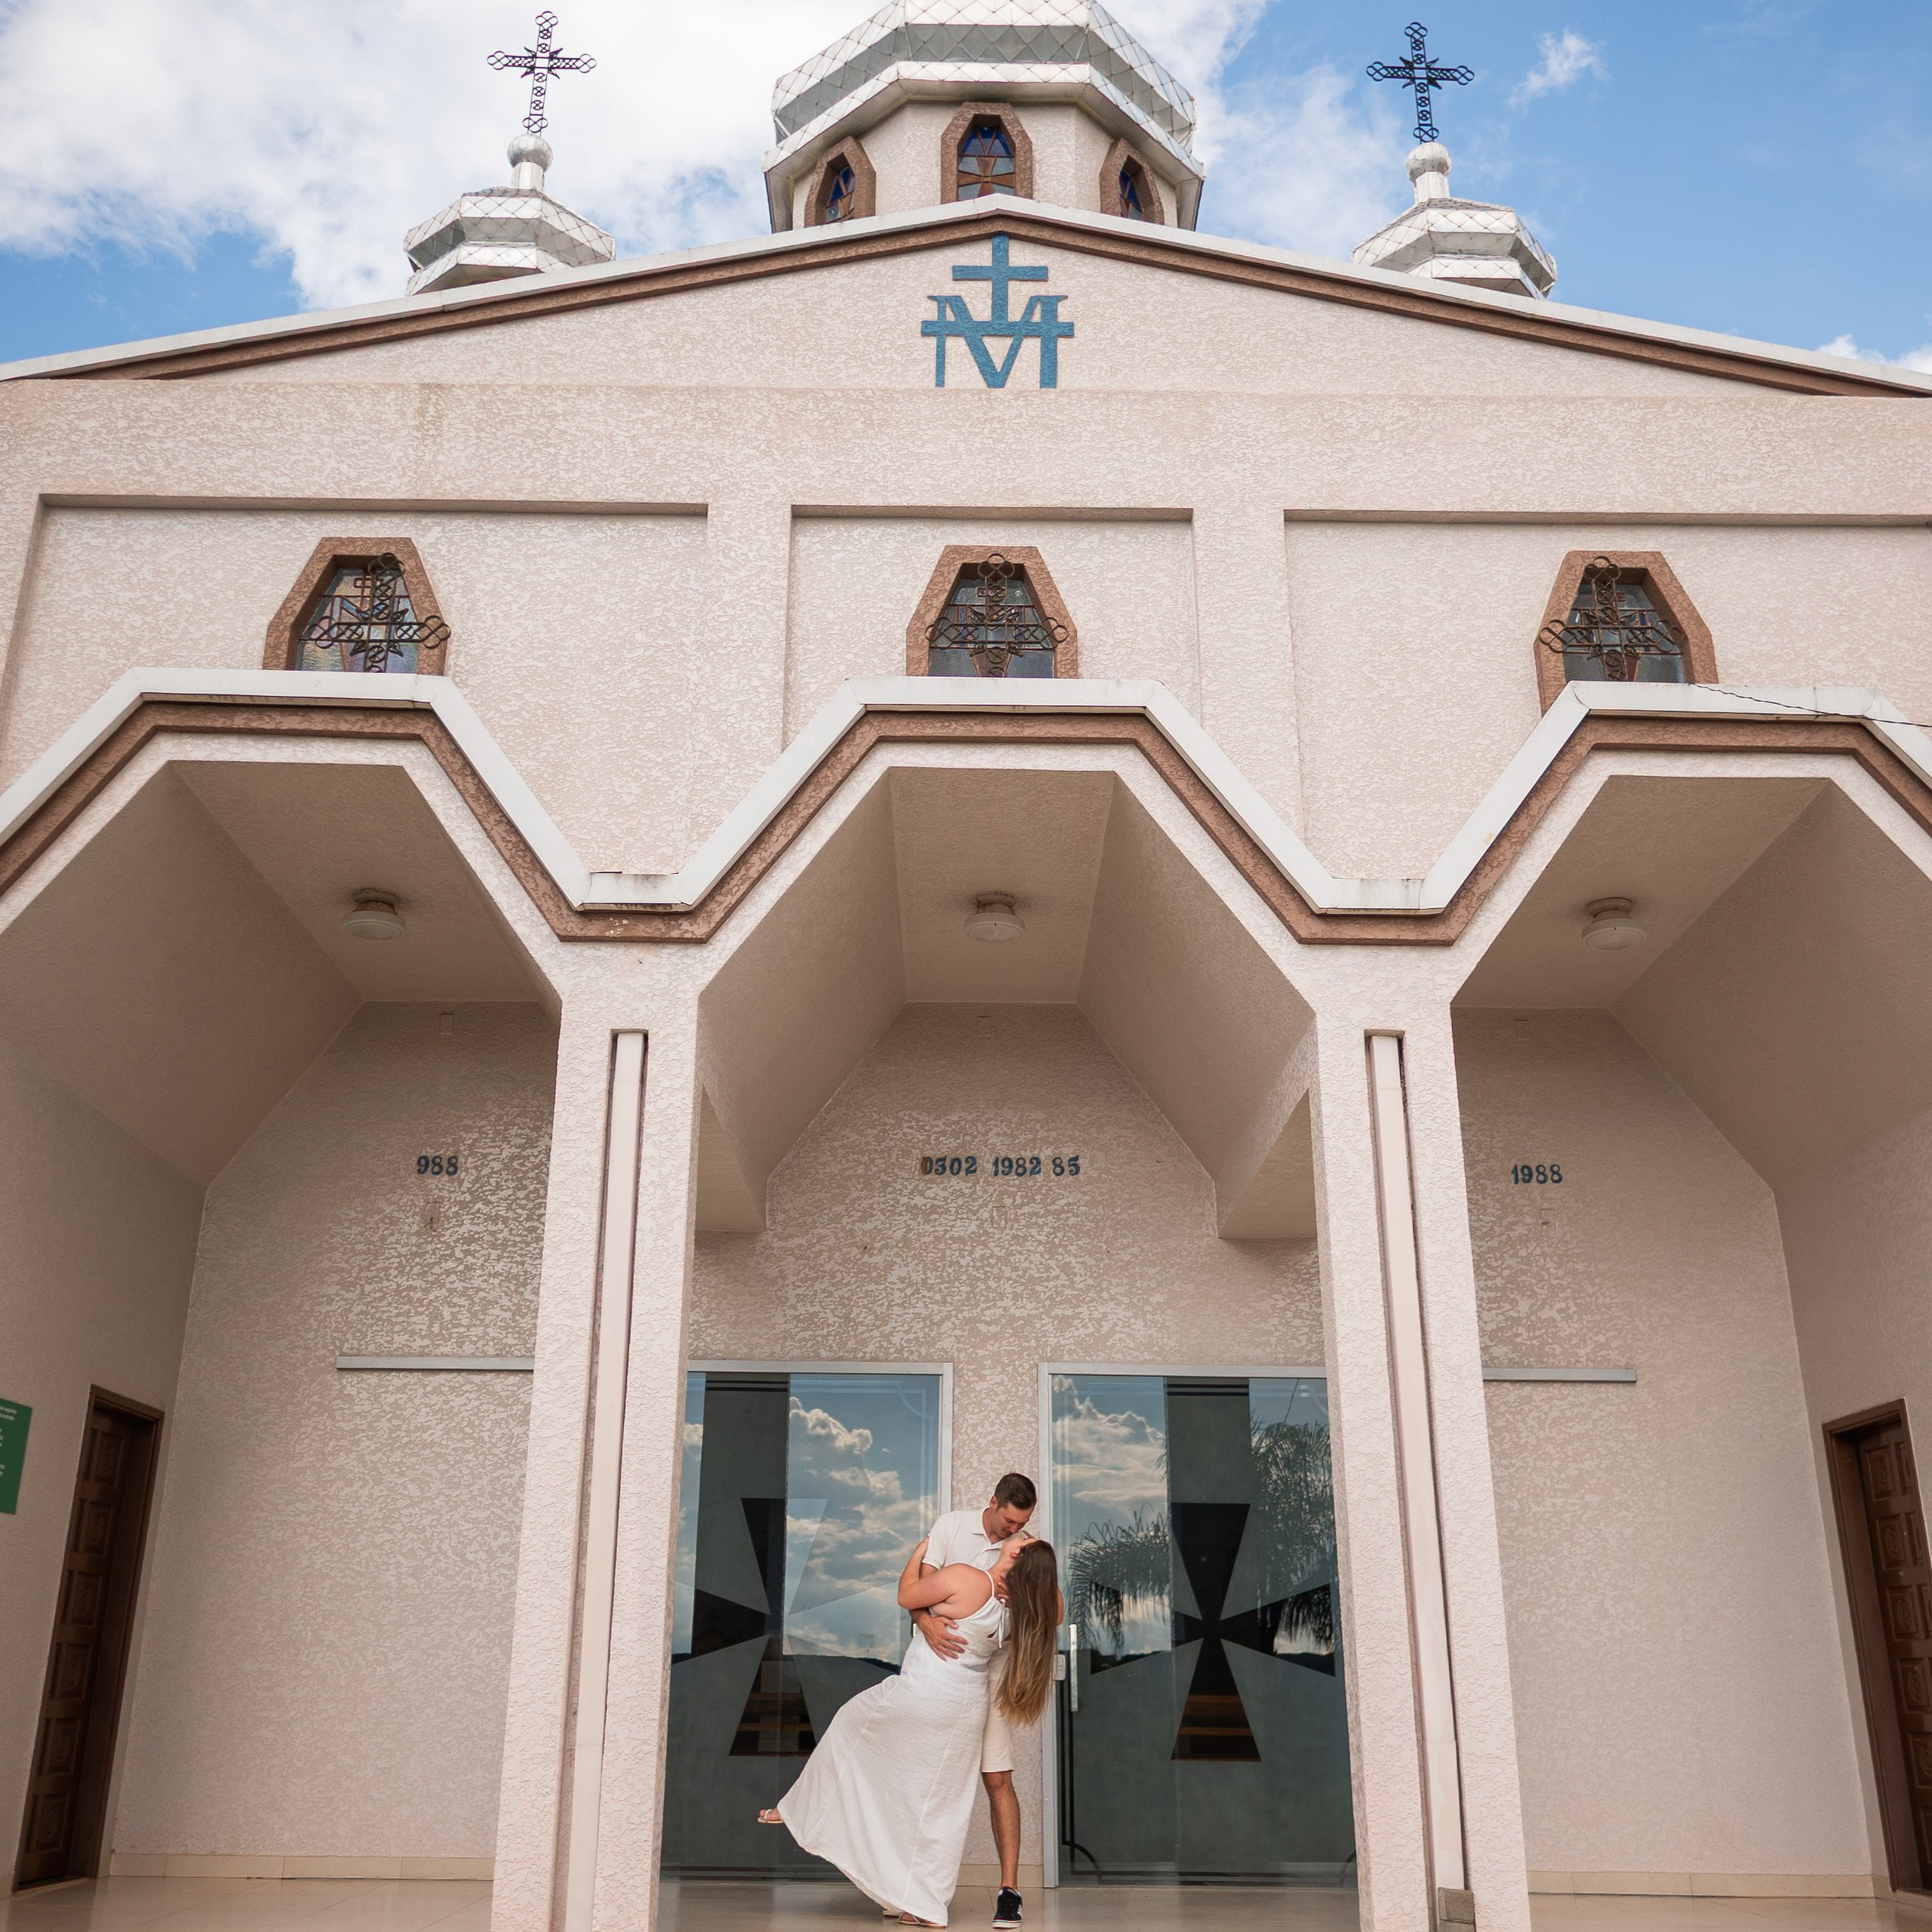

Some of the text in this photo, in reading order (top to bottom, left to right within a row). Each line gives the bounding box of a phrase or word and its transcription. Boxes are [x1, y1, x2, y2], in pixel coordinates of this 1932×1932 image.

[417, 1155, 459, 1175] 988
[992, 1156, 1041, 1177] 1982
[1052, 1155, 1081, 1176] 85
[1512, 1164, 1563, 1184] 1988
